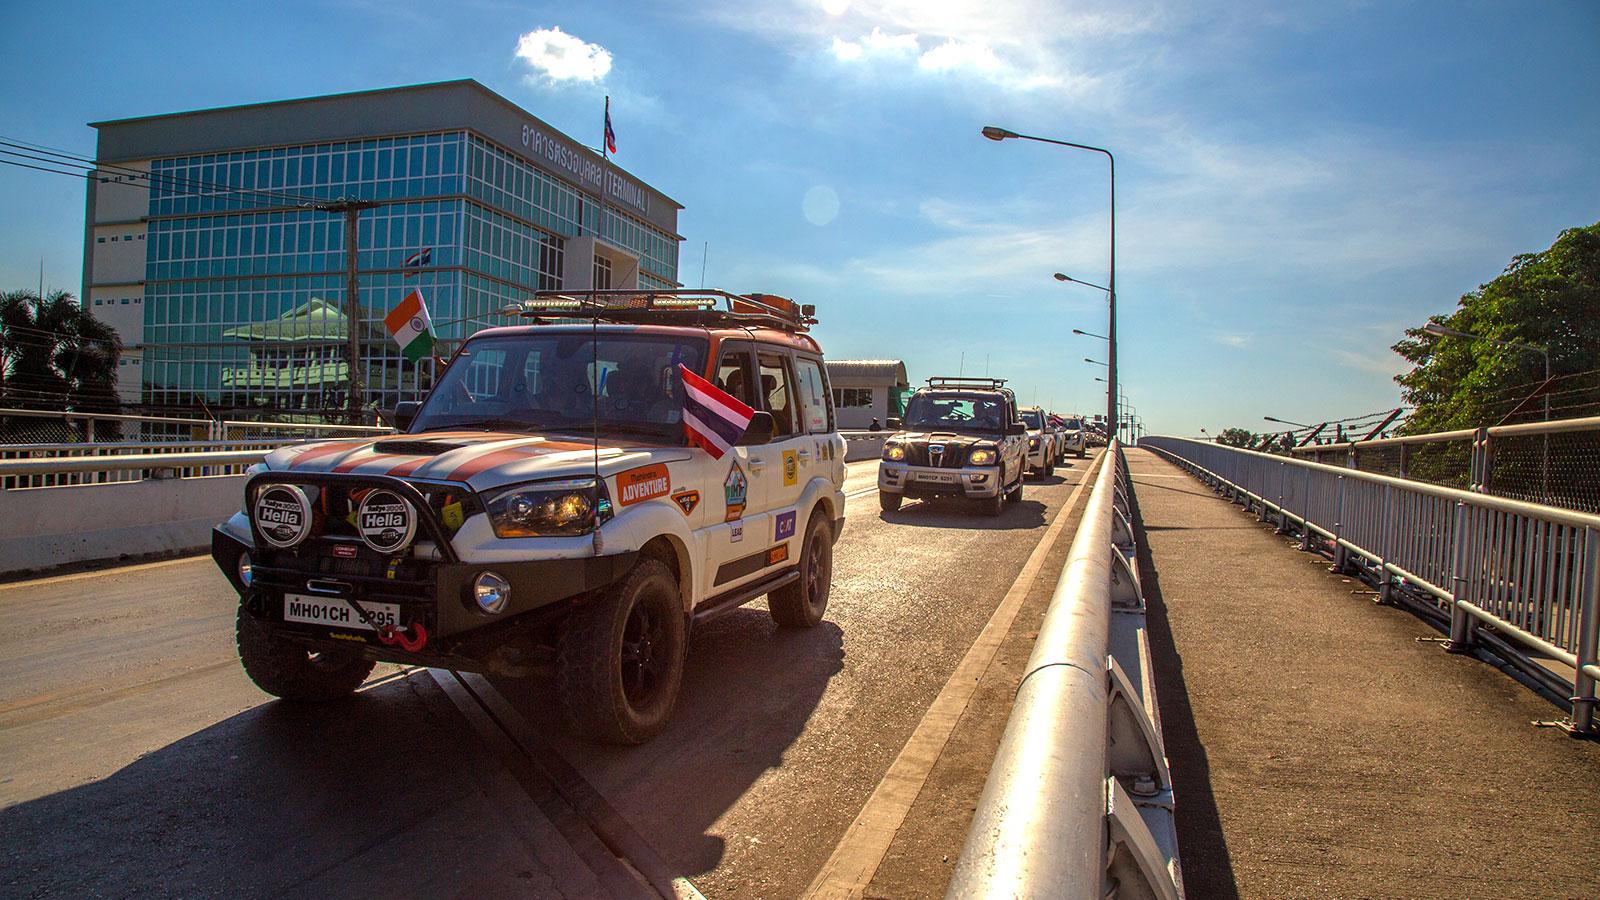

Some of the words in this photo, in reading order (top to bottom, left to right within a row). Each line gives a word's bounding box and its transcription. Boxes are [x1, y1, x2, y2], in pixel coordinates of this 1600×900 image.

[622, 477, 668, 502] ADVENTURE
[262, 507, 298, 525] Hella
[366, 512, 403, 528] Hella
[289, 602, 350, 623] MH01CH
